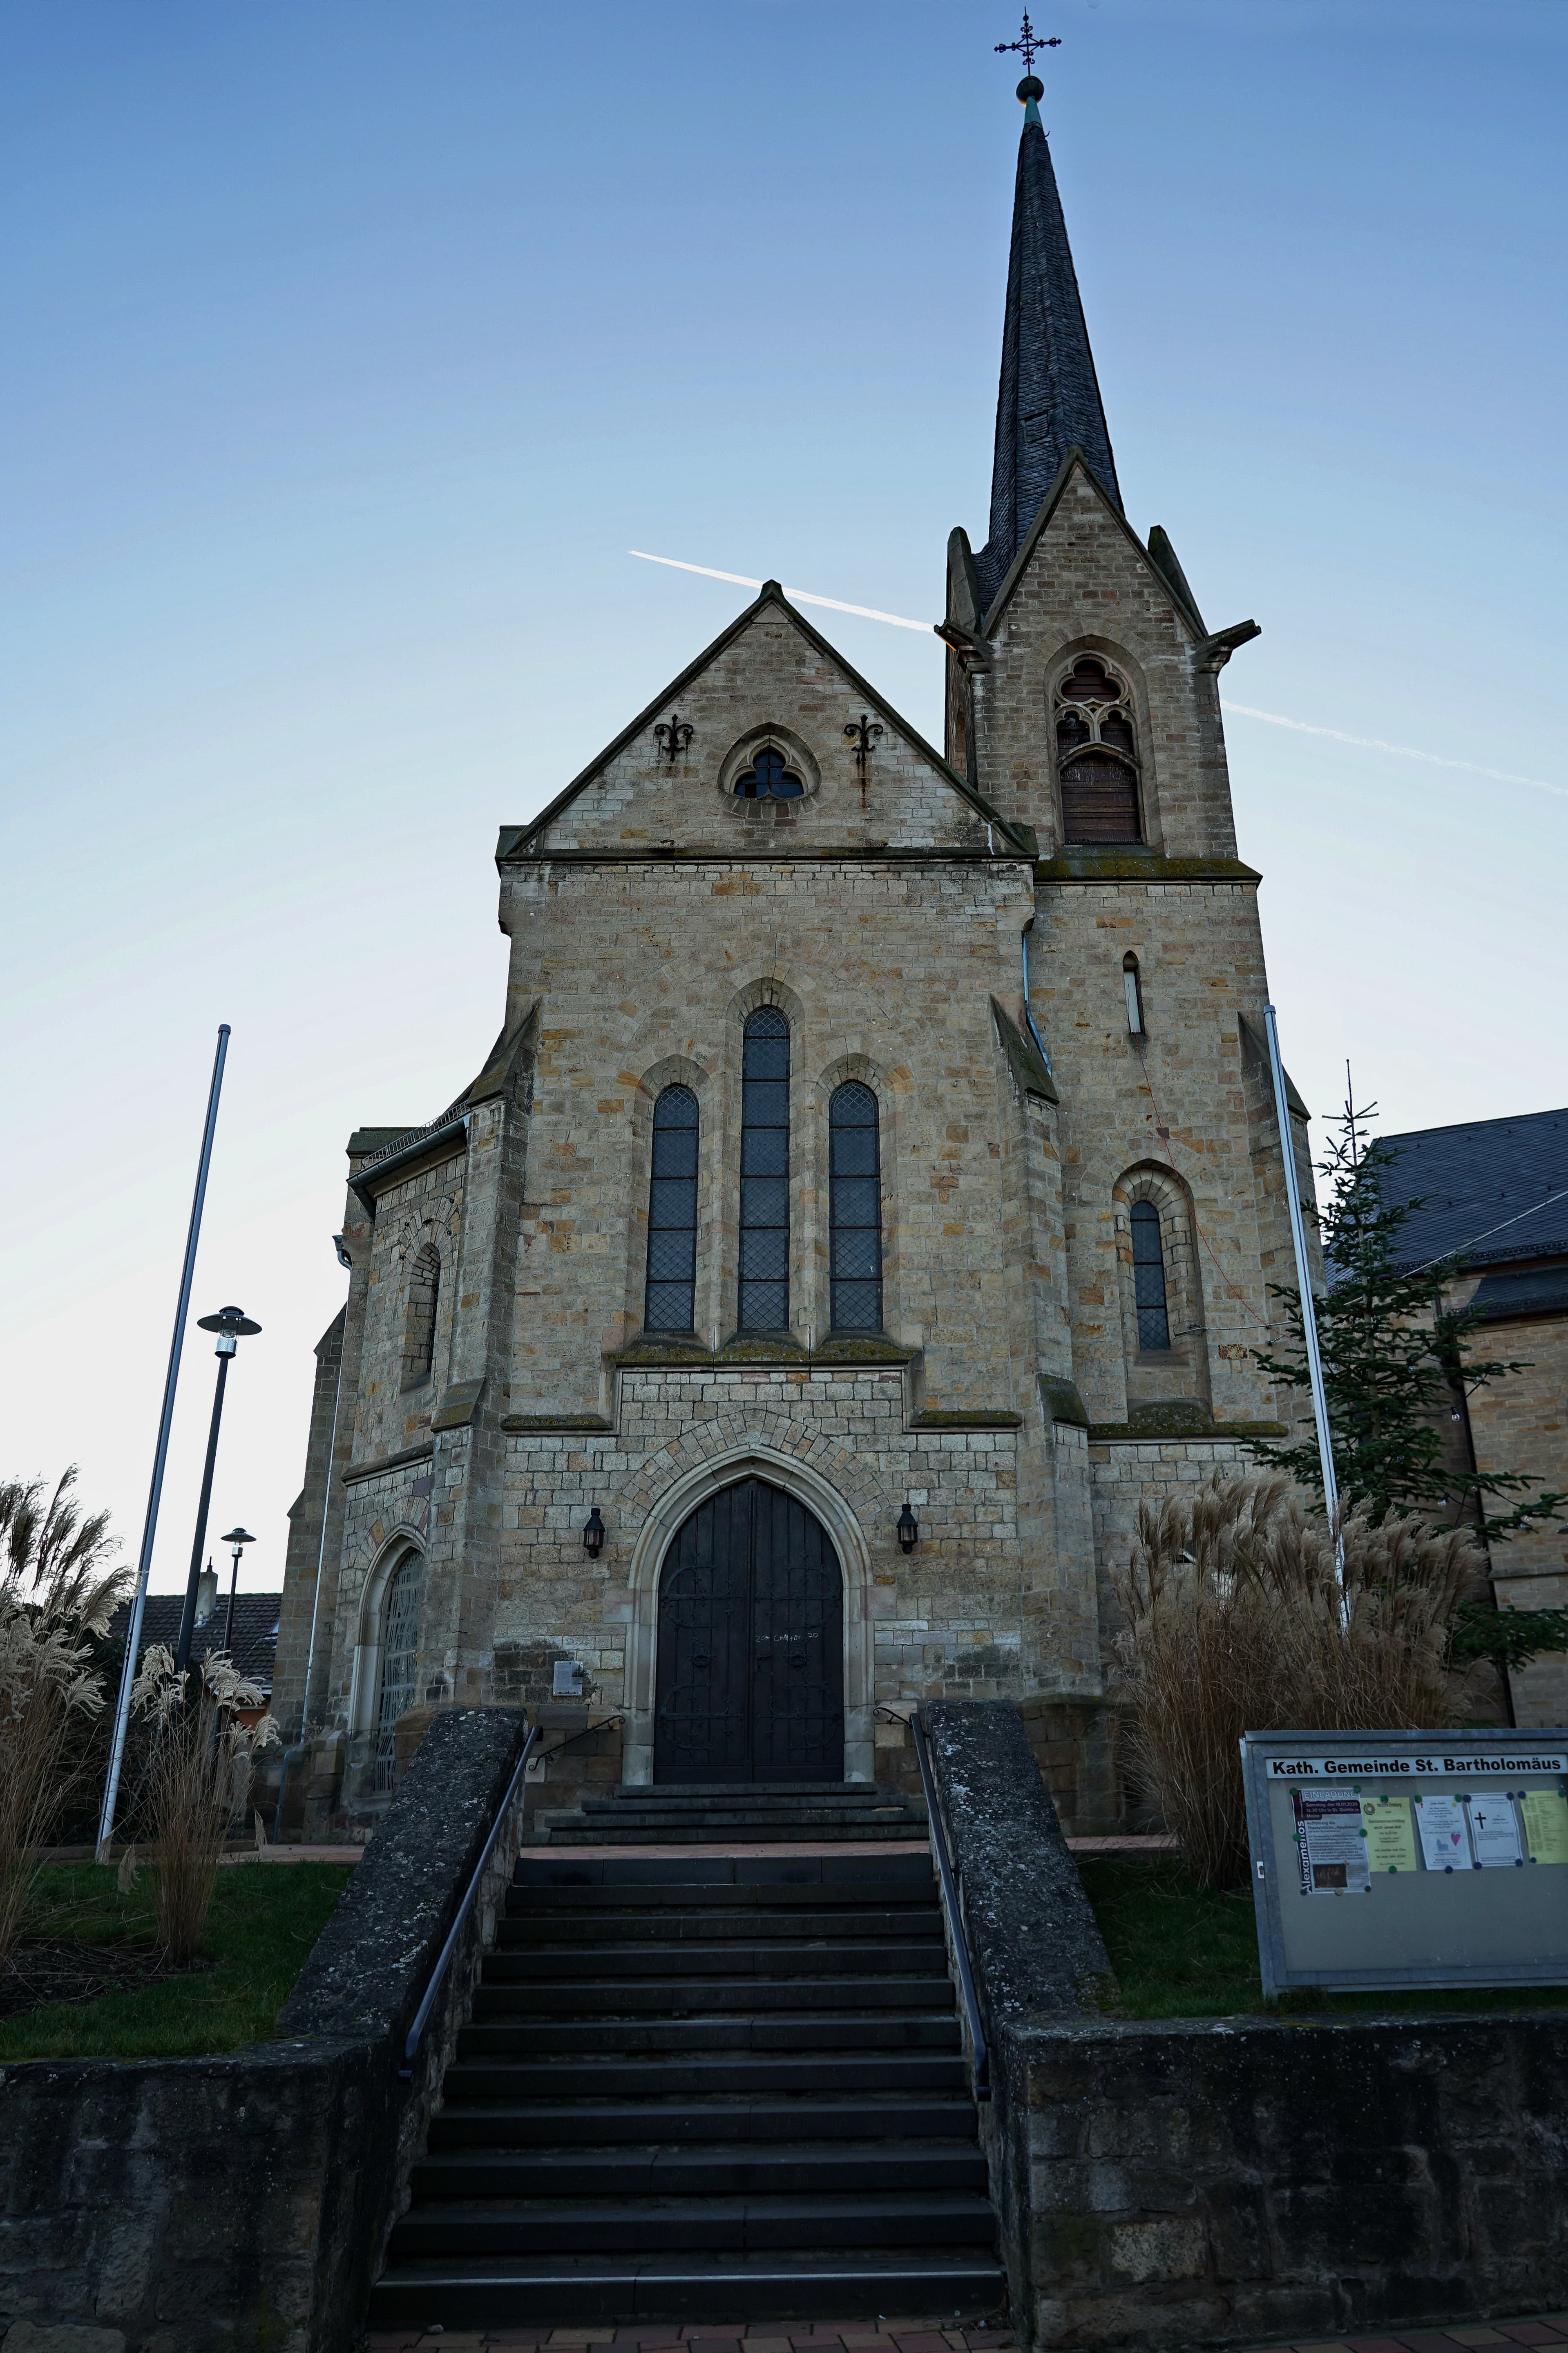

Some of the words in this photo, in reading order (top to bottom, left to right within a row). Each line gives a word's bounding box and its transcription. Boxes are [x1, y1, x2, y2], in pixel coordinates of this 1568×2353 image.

[1273, 1761, 1319, 1774] Kath.
[1324, 1760, 1410, 1774] Gemeinde
[1415, 1759, 1438, 1772] St.
[1443, 1758, 1561, 1771] Bartholomäus
